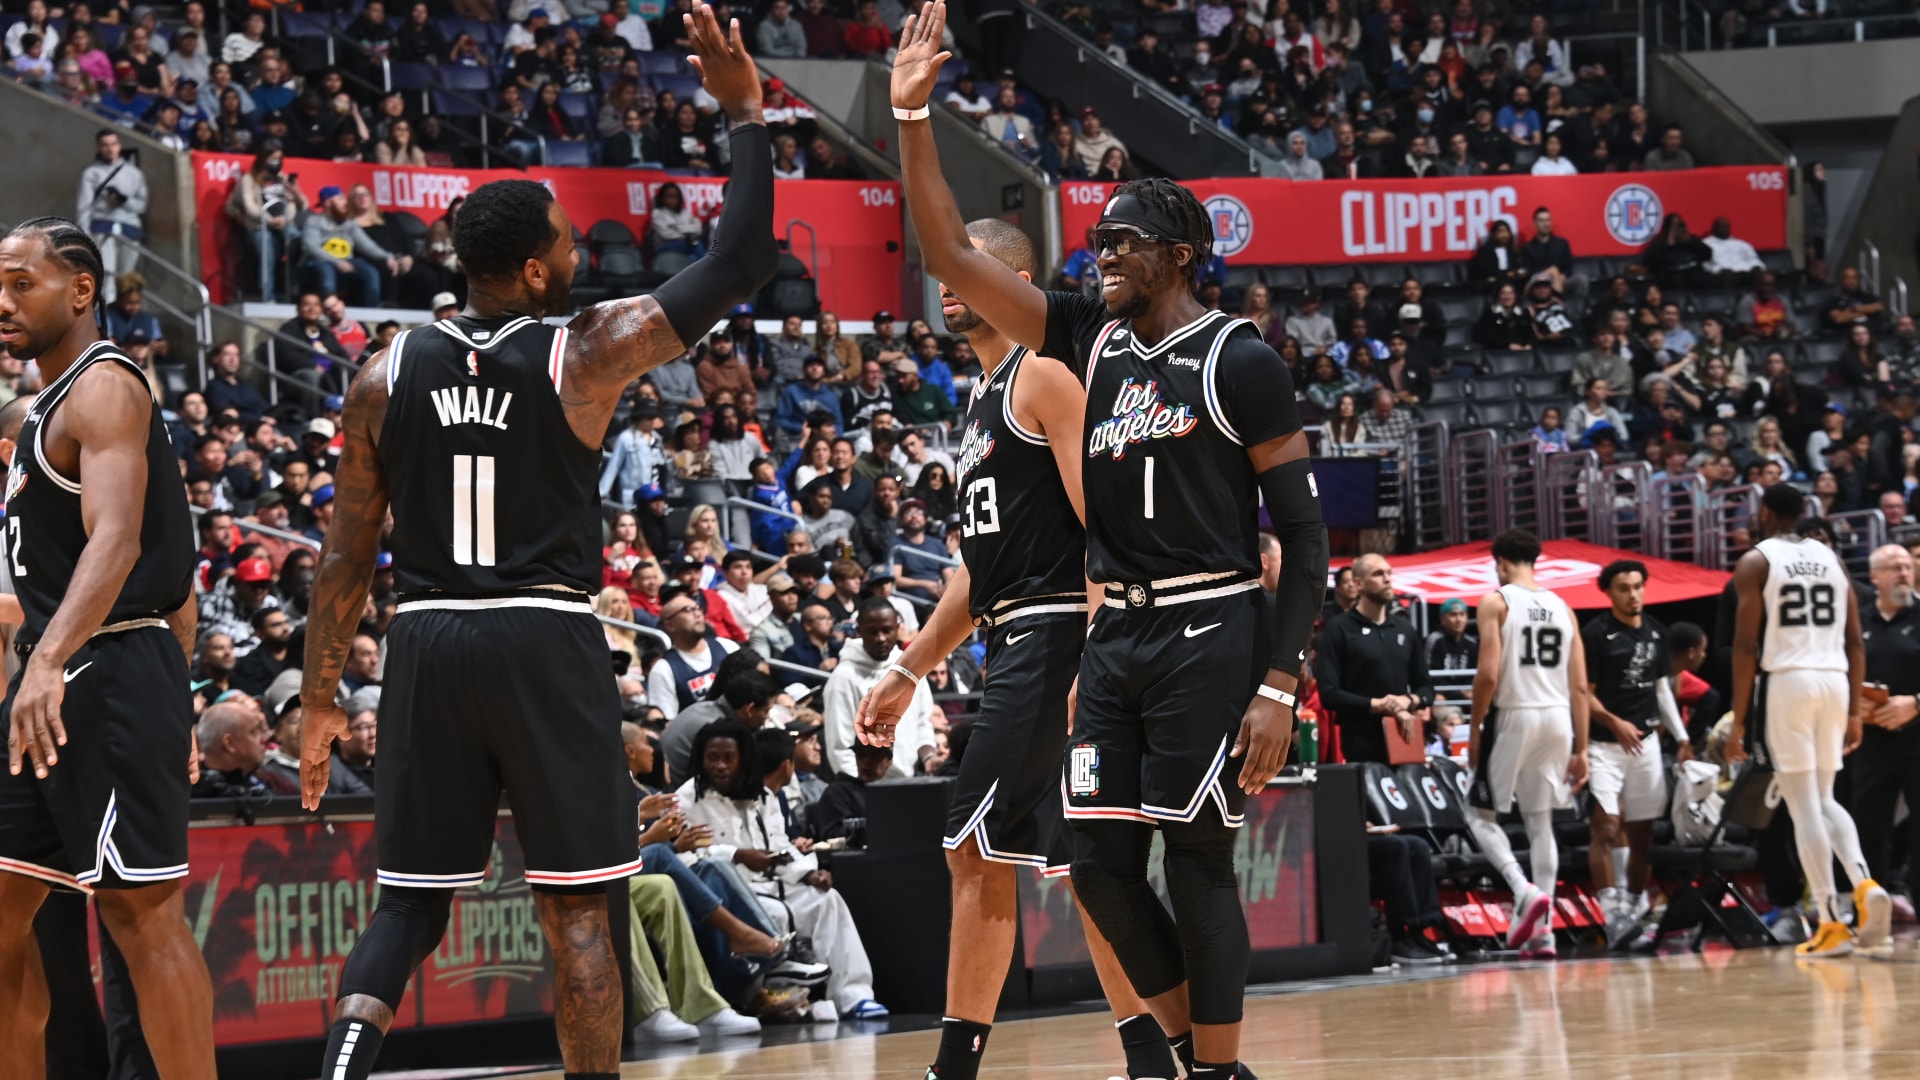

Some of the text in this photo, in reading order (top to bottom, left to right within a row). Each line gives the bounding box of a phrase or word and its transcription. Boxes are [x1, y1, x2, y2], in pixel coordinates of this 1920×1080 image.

[203, 159, 241, 181] 104
[1747, 171, 1784, 190] 105
[859, 187, 896, 207] 104
[1068, 185, 1105, 204] 105
[1341, 185, 1519, 257] CLIPPERS
[1167, 353, 1201, 371] honey
[430, 385, 513, 431] WALL
[1112, 380, 1158, 417] los
[1089, 402, 1194, 458] angeles
[962, 476, 1001, 538] 33
[1144, 456, 1155, 519] 1
[453, 454, 496, 567] 11
[9, 515, 28, 577] 2
[1779, 583, 1835, 627] 28
[1519, 625, 1563, 669] 18
[1380, 776, 1409, 811] G
[1420, 776, 1448, 811] G
[433, 895, 545, 970] LIPPERS
[256, 963, 339, 1006] ATTORNEY
